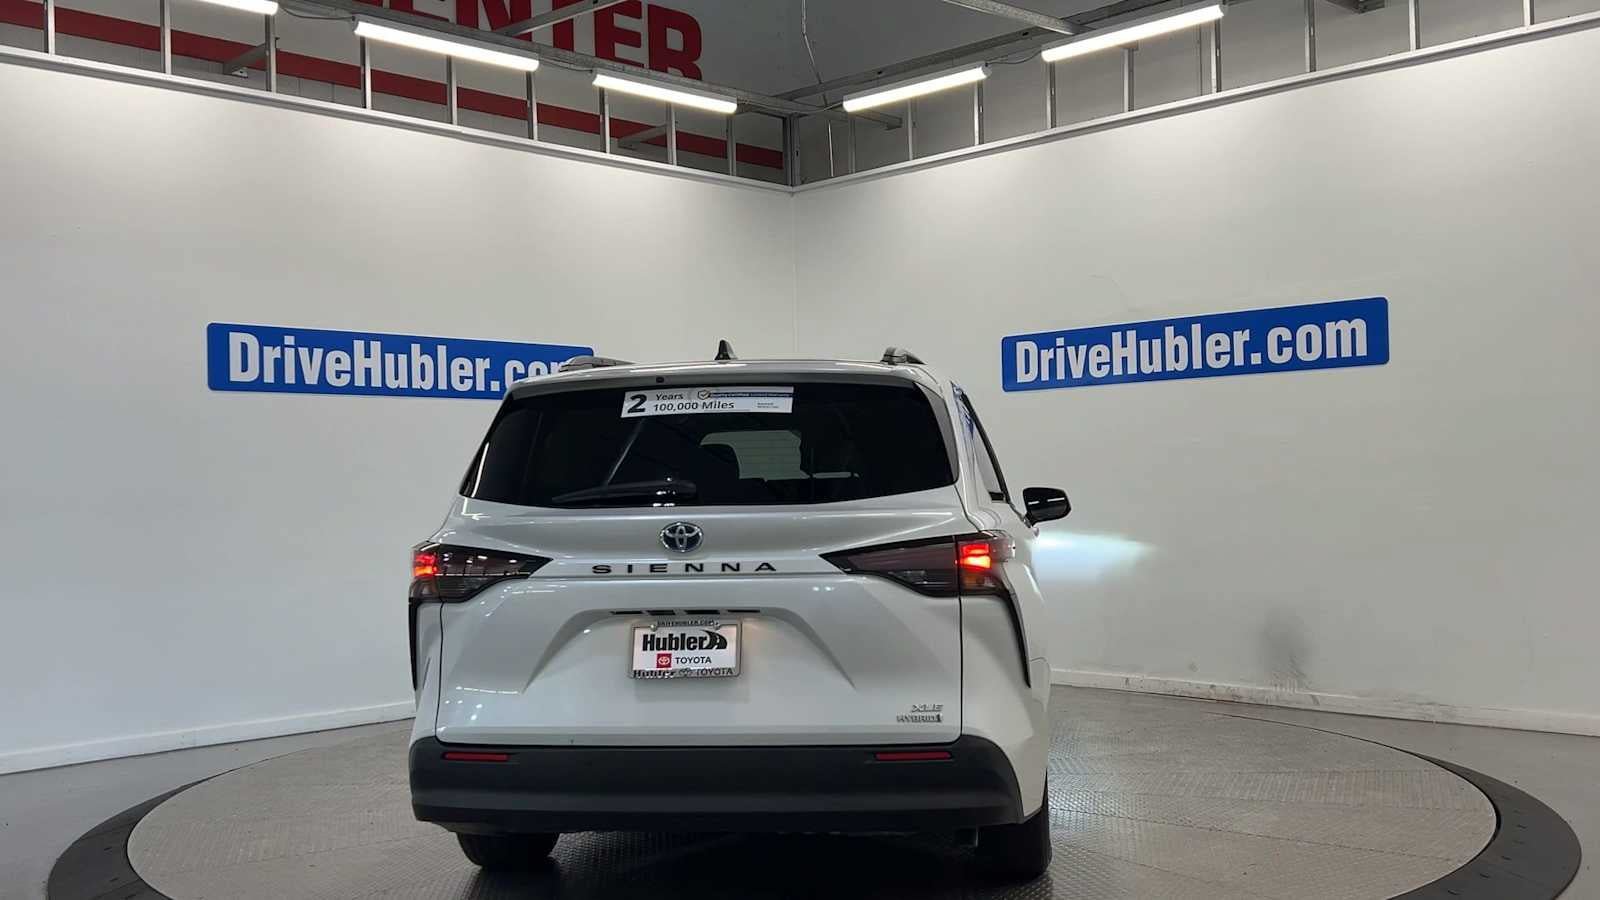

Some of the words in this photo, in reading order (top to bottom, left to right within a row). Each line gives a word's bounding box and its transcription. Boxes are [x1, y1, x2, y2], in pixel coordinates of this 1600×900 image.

[1015, 317, 1367, 383] DriveHubler.com
[655, 393, 684, 401] Years
[627, 394, 648, 413] 2
[653, 402, 699, 412] 100,000
[702, 400, 735, 410] Miles
[592, 562, 777, 574] SIENNA
[642, 633, 708, 652] Hubler
[675, 656, 712, 664] TOYOTA
[696, 667, 734, 676] TOYOTA
